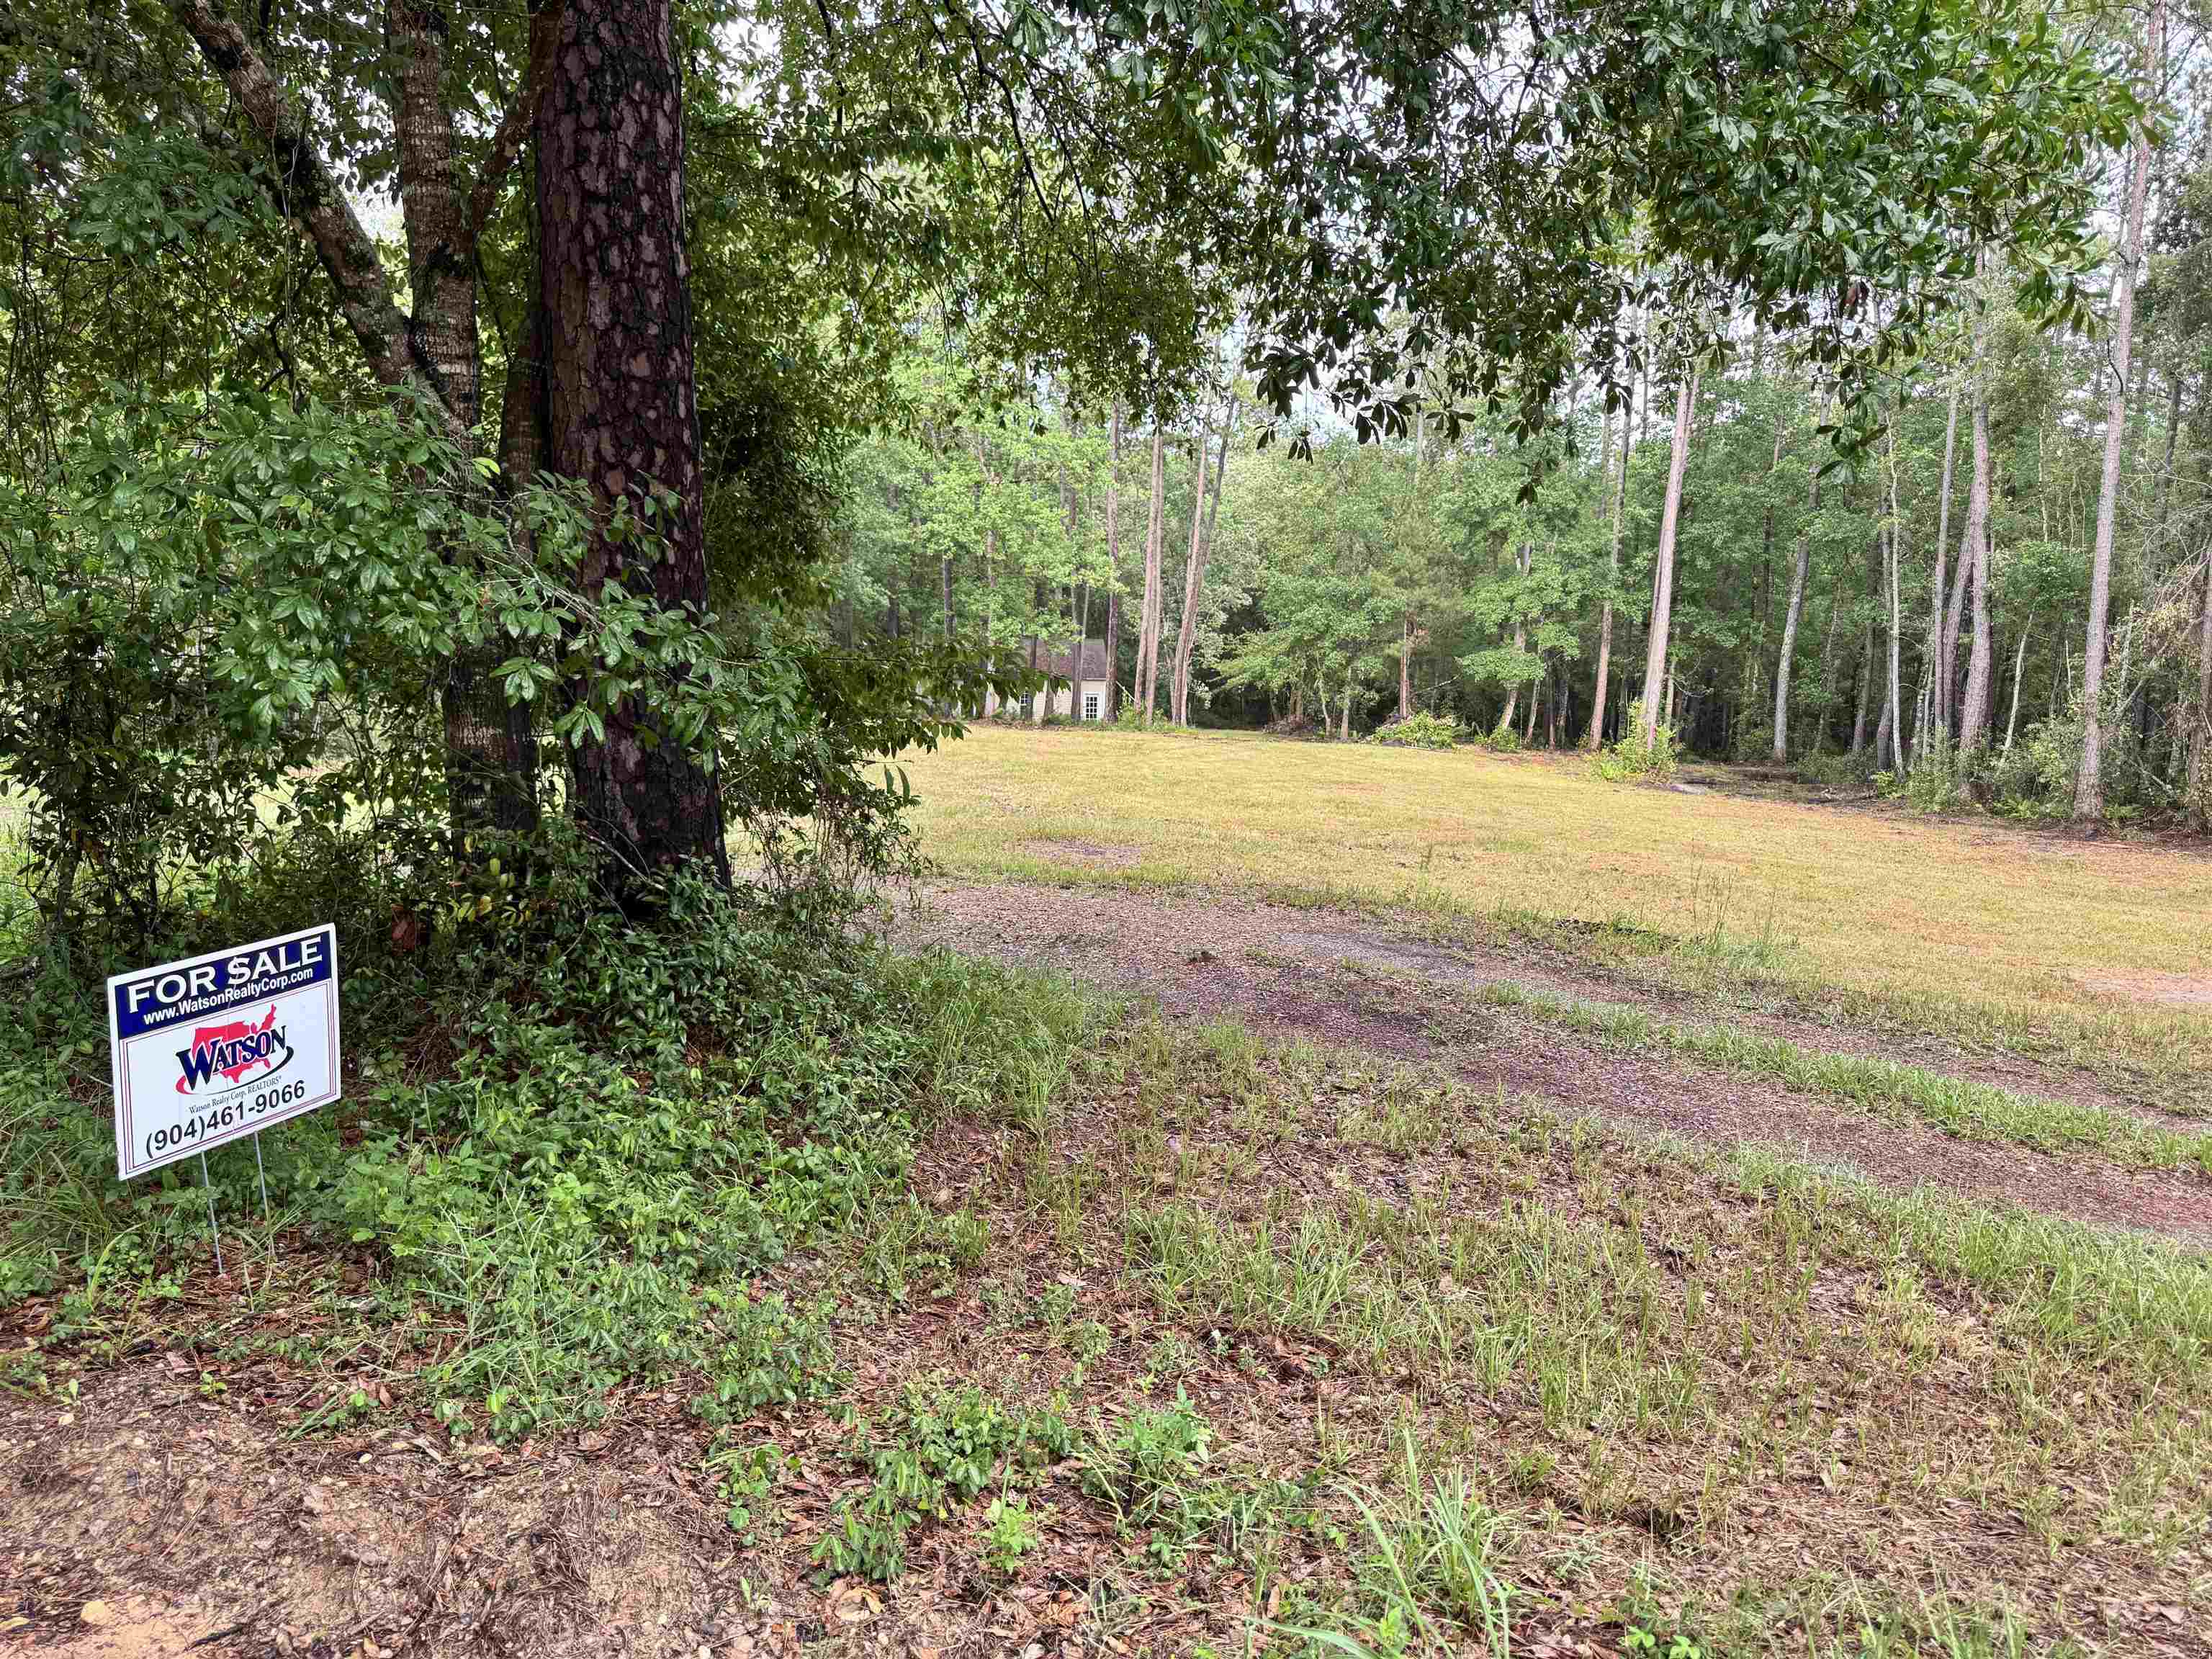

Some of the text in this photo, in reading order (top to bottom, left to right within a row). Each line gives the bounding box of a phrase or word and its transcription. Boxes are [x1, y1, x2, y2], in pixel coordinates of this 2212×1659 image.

[128, 967, 217, 1014] FOR
[144, 967, 313, 1025] www.WatsonRealtyCorp.com
[145, 1079, 305, 1159] (904)461-9066
